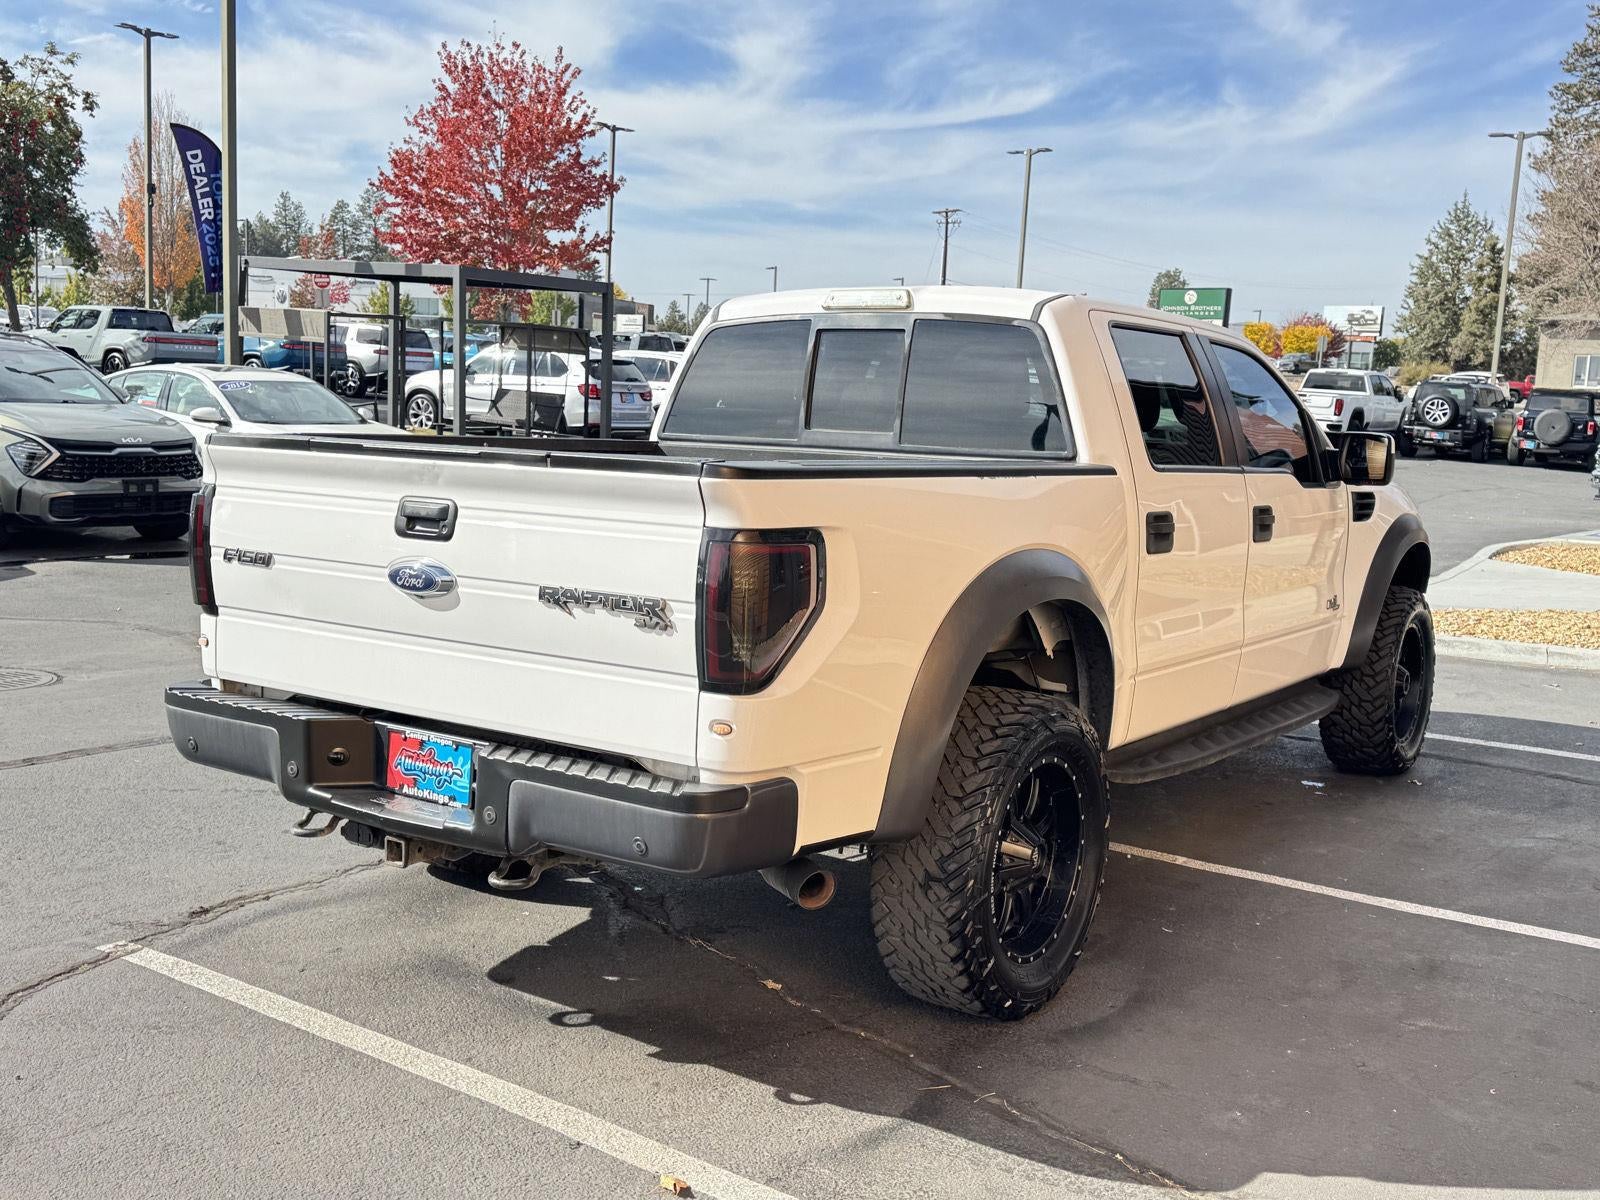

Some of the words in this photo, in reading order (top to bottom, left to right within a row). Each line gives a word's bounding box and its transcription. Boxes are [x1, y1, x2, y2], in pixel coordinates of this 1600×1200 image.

[185, 149, 215, 221] DEALER
[202, 222, 220, 267] 2025
[396, 568, 426, 588] Ford
[539, 585, 672, 627] RAPTOR
[405, 730, 429, 740] Central
[429, 735, 453, 746] Oregon
